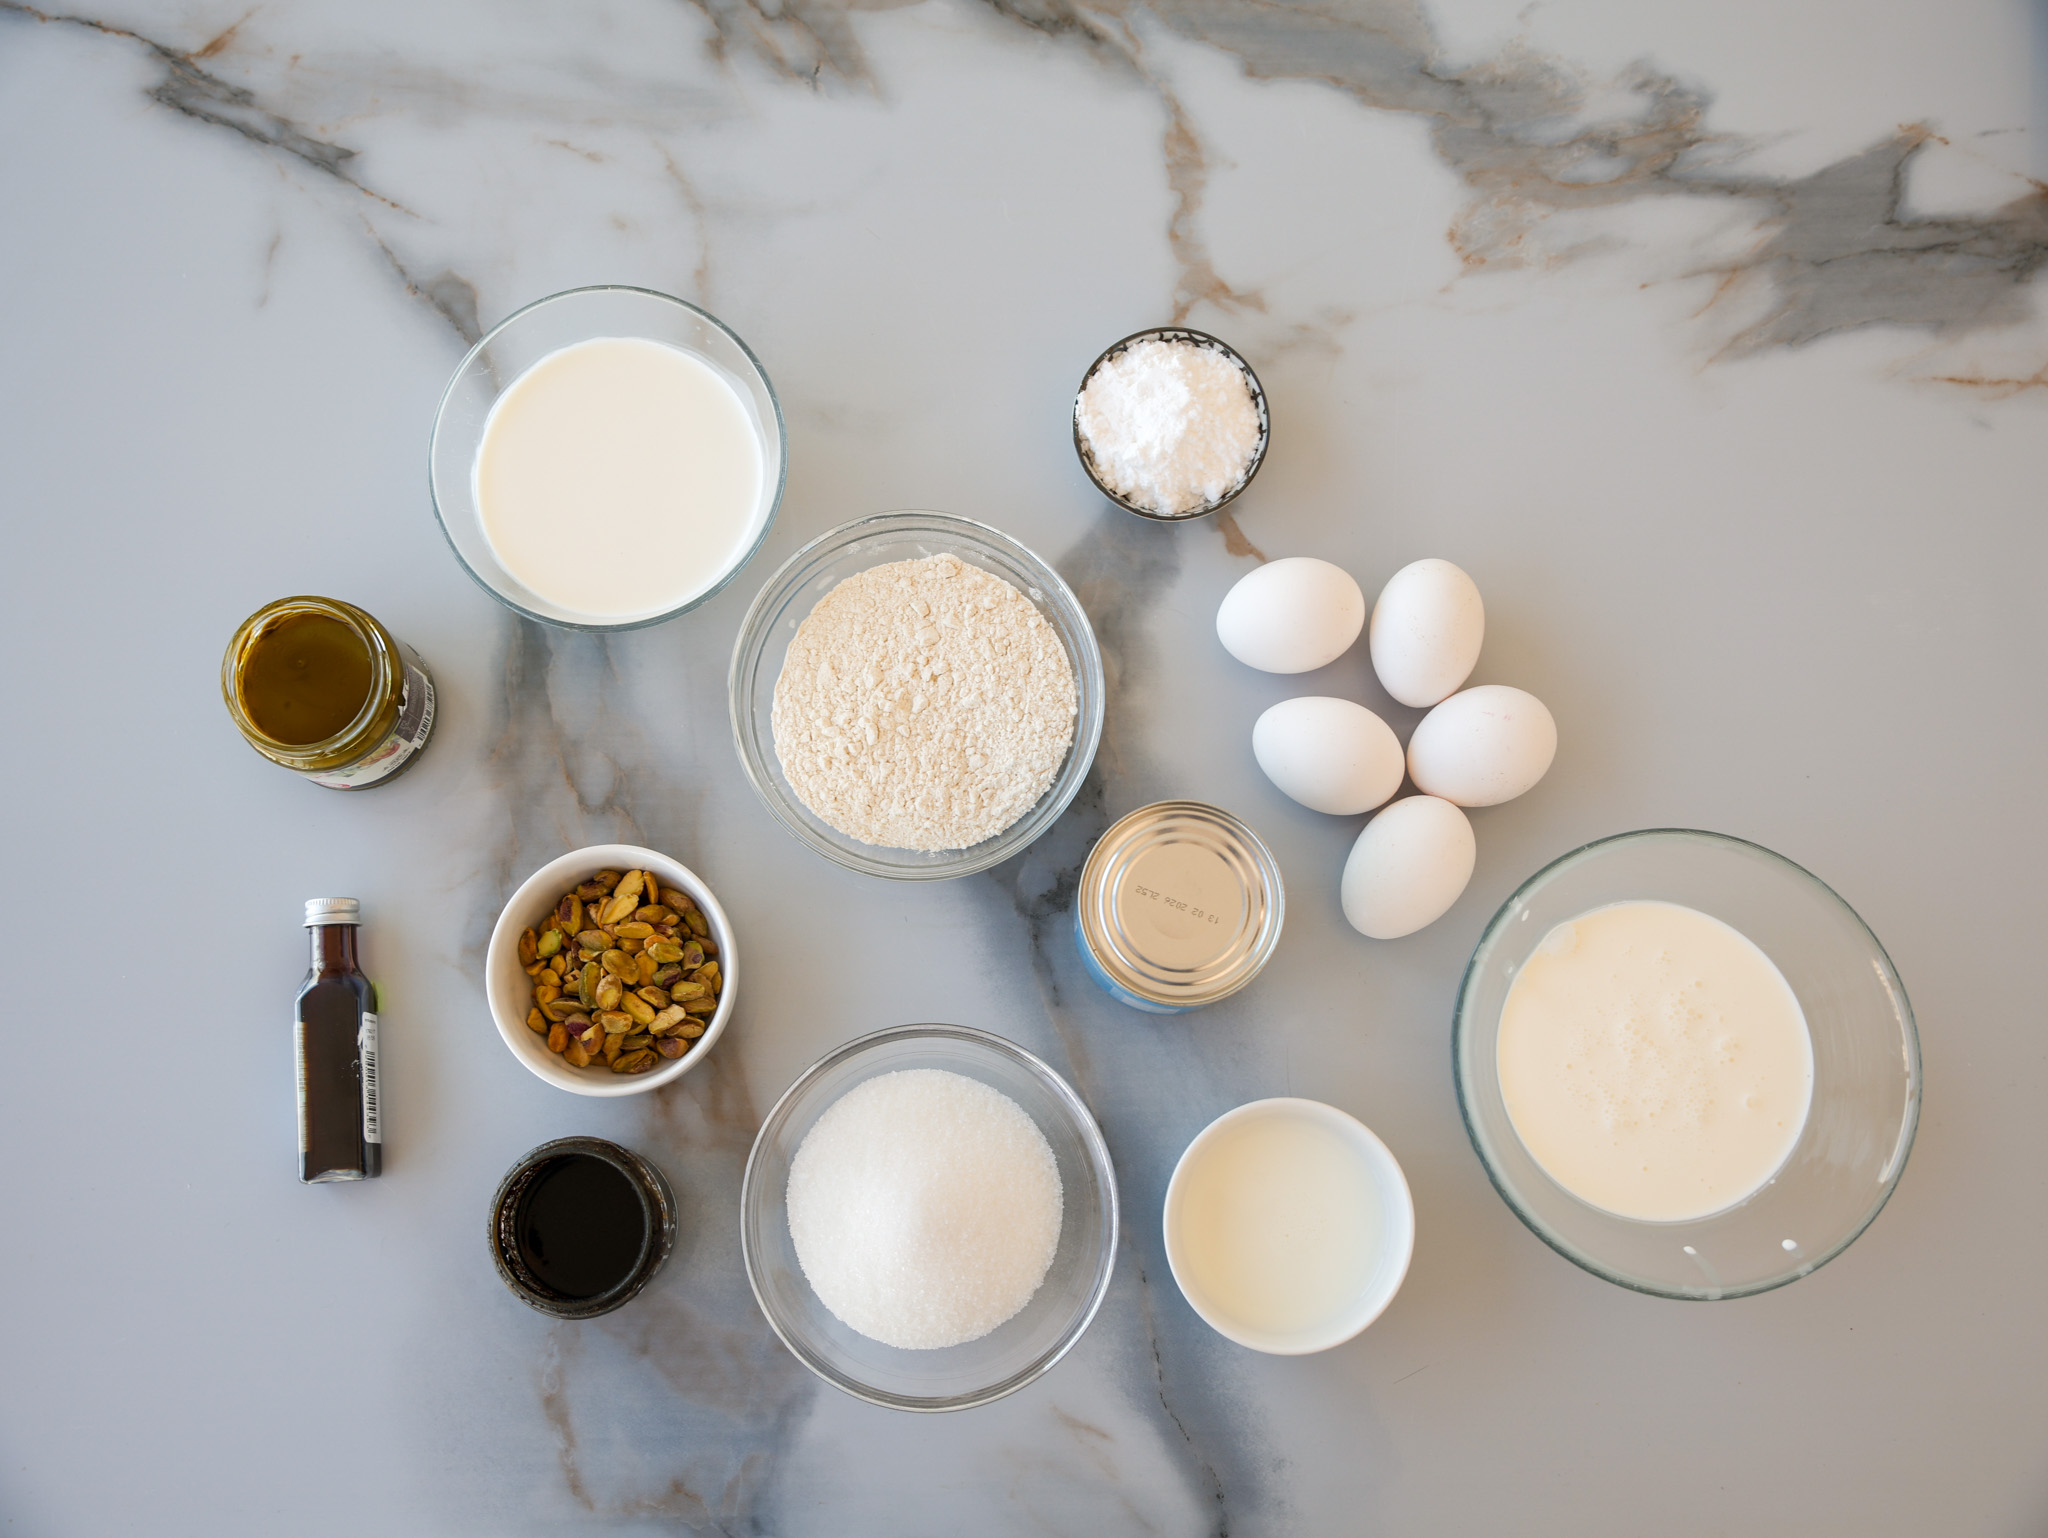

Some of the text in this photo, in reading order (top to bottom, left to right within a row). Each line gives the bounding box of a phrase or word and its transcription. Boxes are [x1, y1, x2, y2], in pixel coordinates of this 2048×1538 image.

[1164, 896, 1188, 911] 2026
[1191, 907, 1204, 918] 02
[1207, 914, 1219, 924] 13
